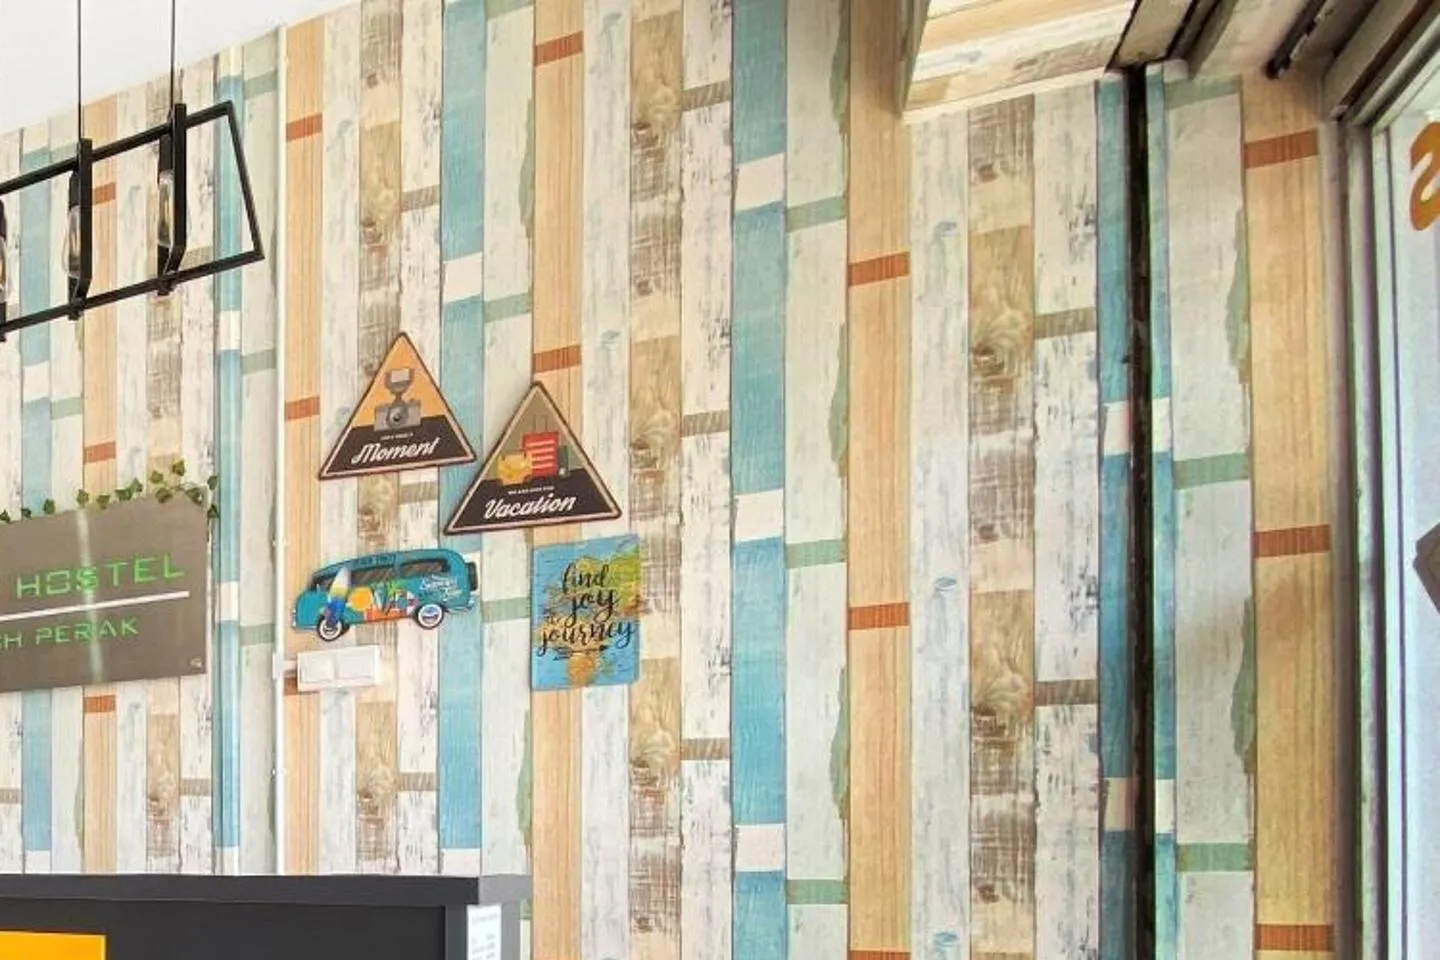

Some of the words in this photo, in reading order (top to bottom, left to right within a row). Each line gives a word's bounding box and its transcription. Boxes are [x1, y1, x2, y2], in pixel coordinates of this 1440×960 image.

[350, 437, 441, 465] Moment
[483, 492, 577, 520] Vacation
[16, 553, 186, 600] HOSTEL
[562, 562, 610, 594] find
[564, 589, 618, 628] joy
[35, 617, 140, 645] PERAK
[537, 621, 634, 657] journey
